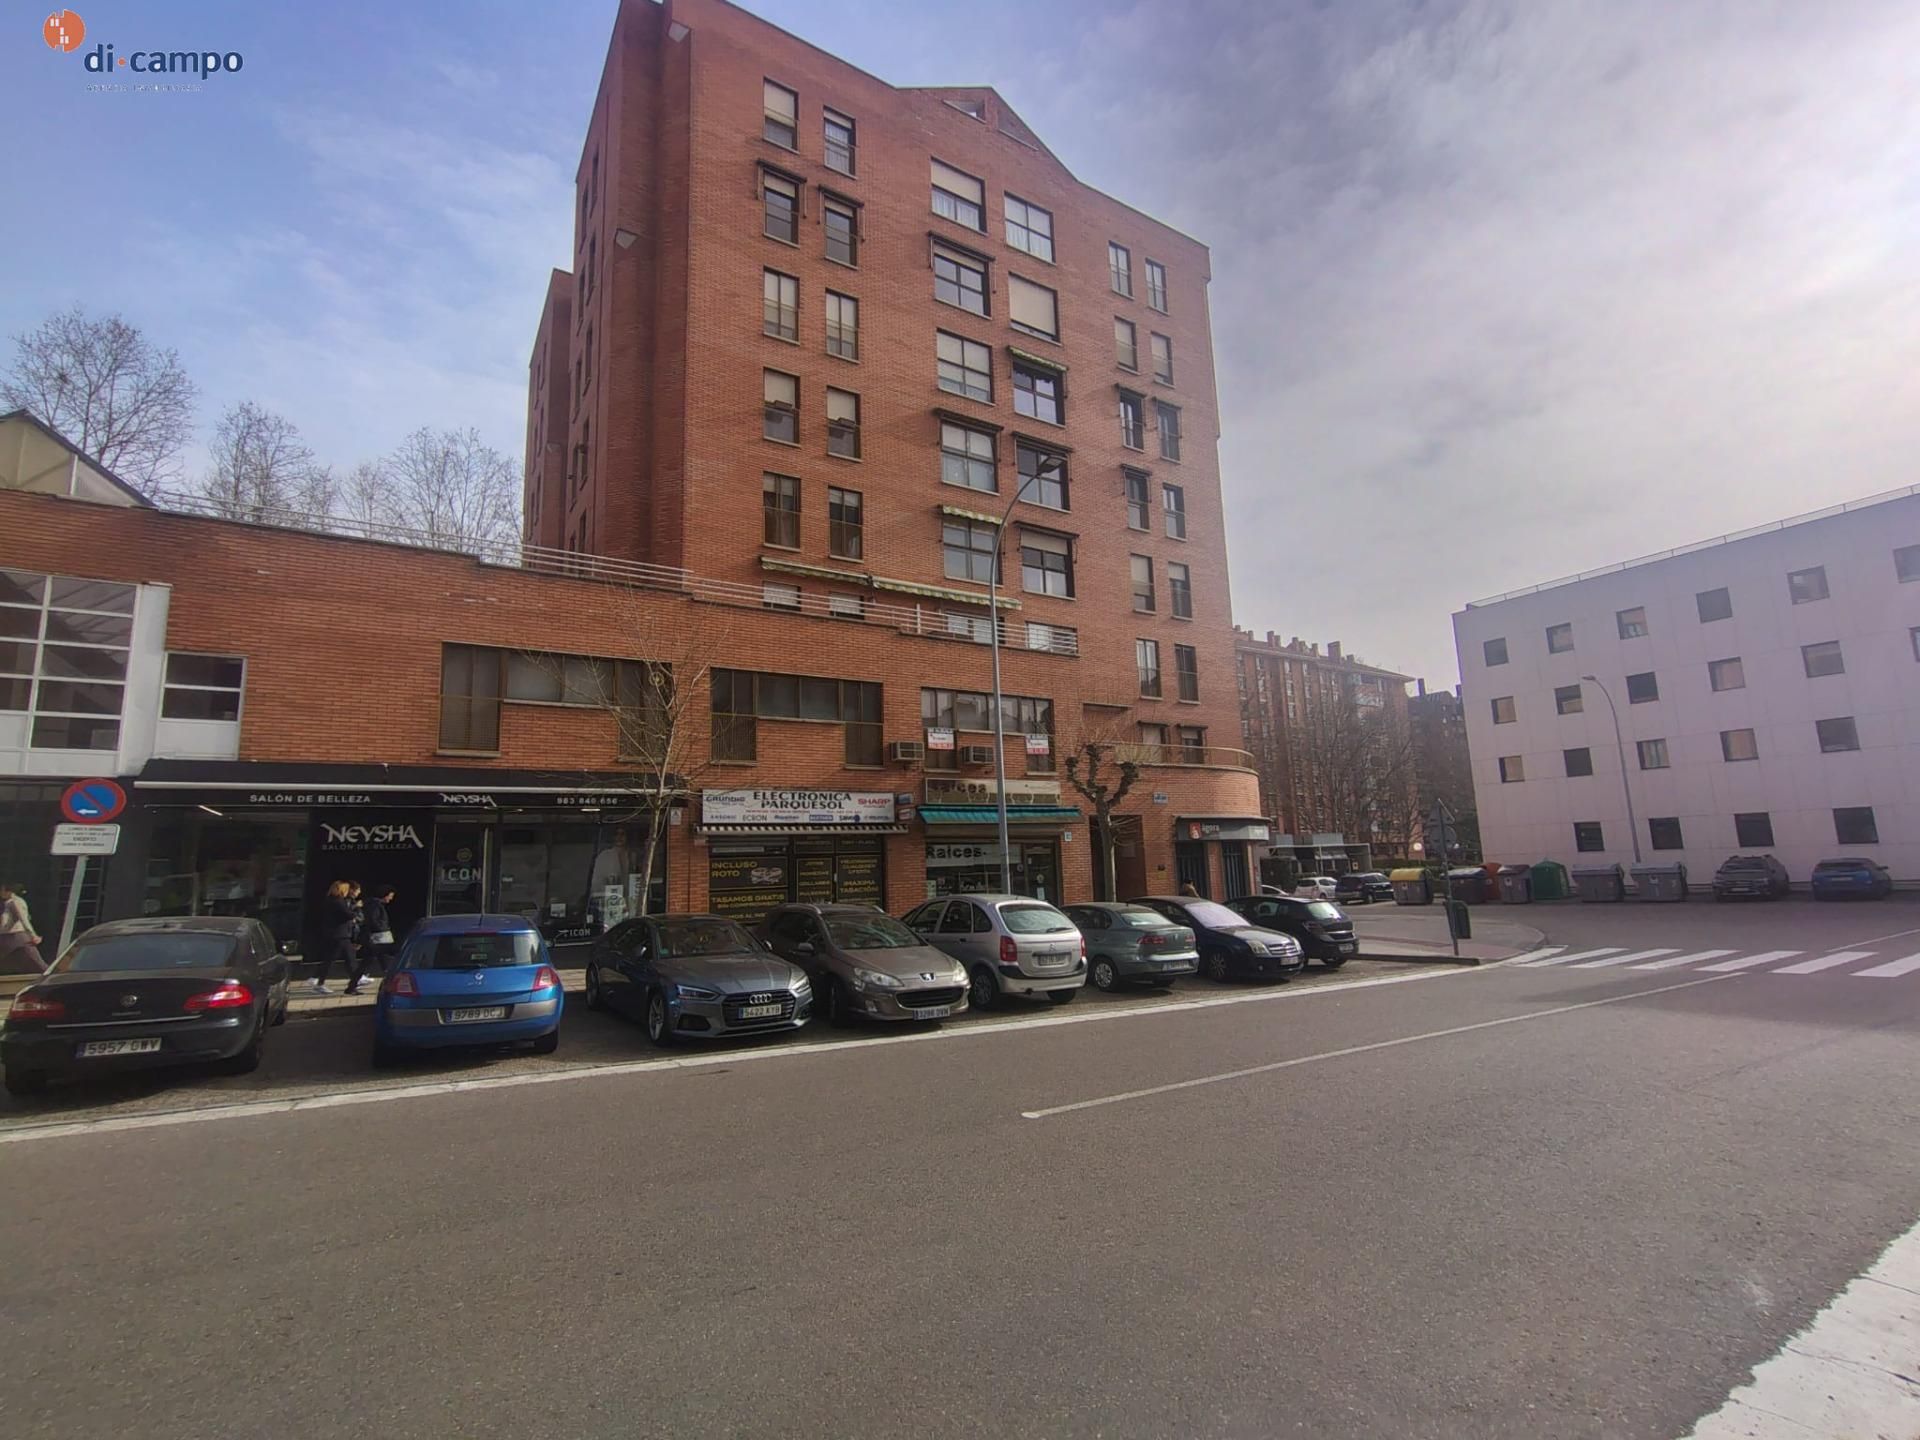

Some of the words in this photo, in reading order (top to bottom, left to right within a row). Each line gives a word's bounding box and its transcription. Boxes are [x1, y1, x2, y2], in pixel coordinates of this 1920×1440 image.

[250, 794, 293, 803] SALÓN
[297, 795, 313, 803] DE
[318, 795, 371, 803] BELLEZA
[440, 793, 497, 807] NEYSHA
[753, 791, 852, 801] ELECTRONICA
[761, 801, 845, 810] PARQUESOL
[320, 823, 424, 848] NEYSHA
[711, 861, 758, 869] INCLUSO
[441, 867, 482, 881] ICON
[711, 870, 740, 878] ROTO
[88, 1041, 126, 1055] 5957
